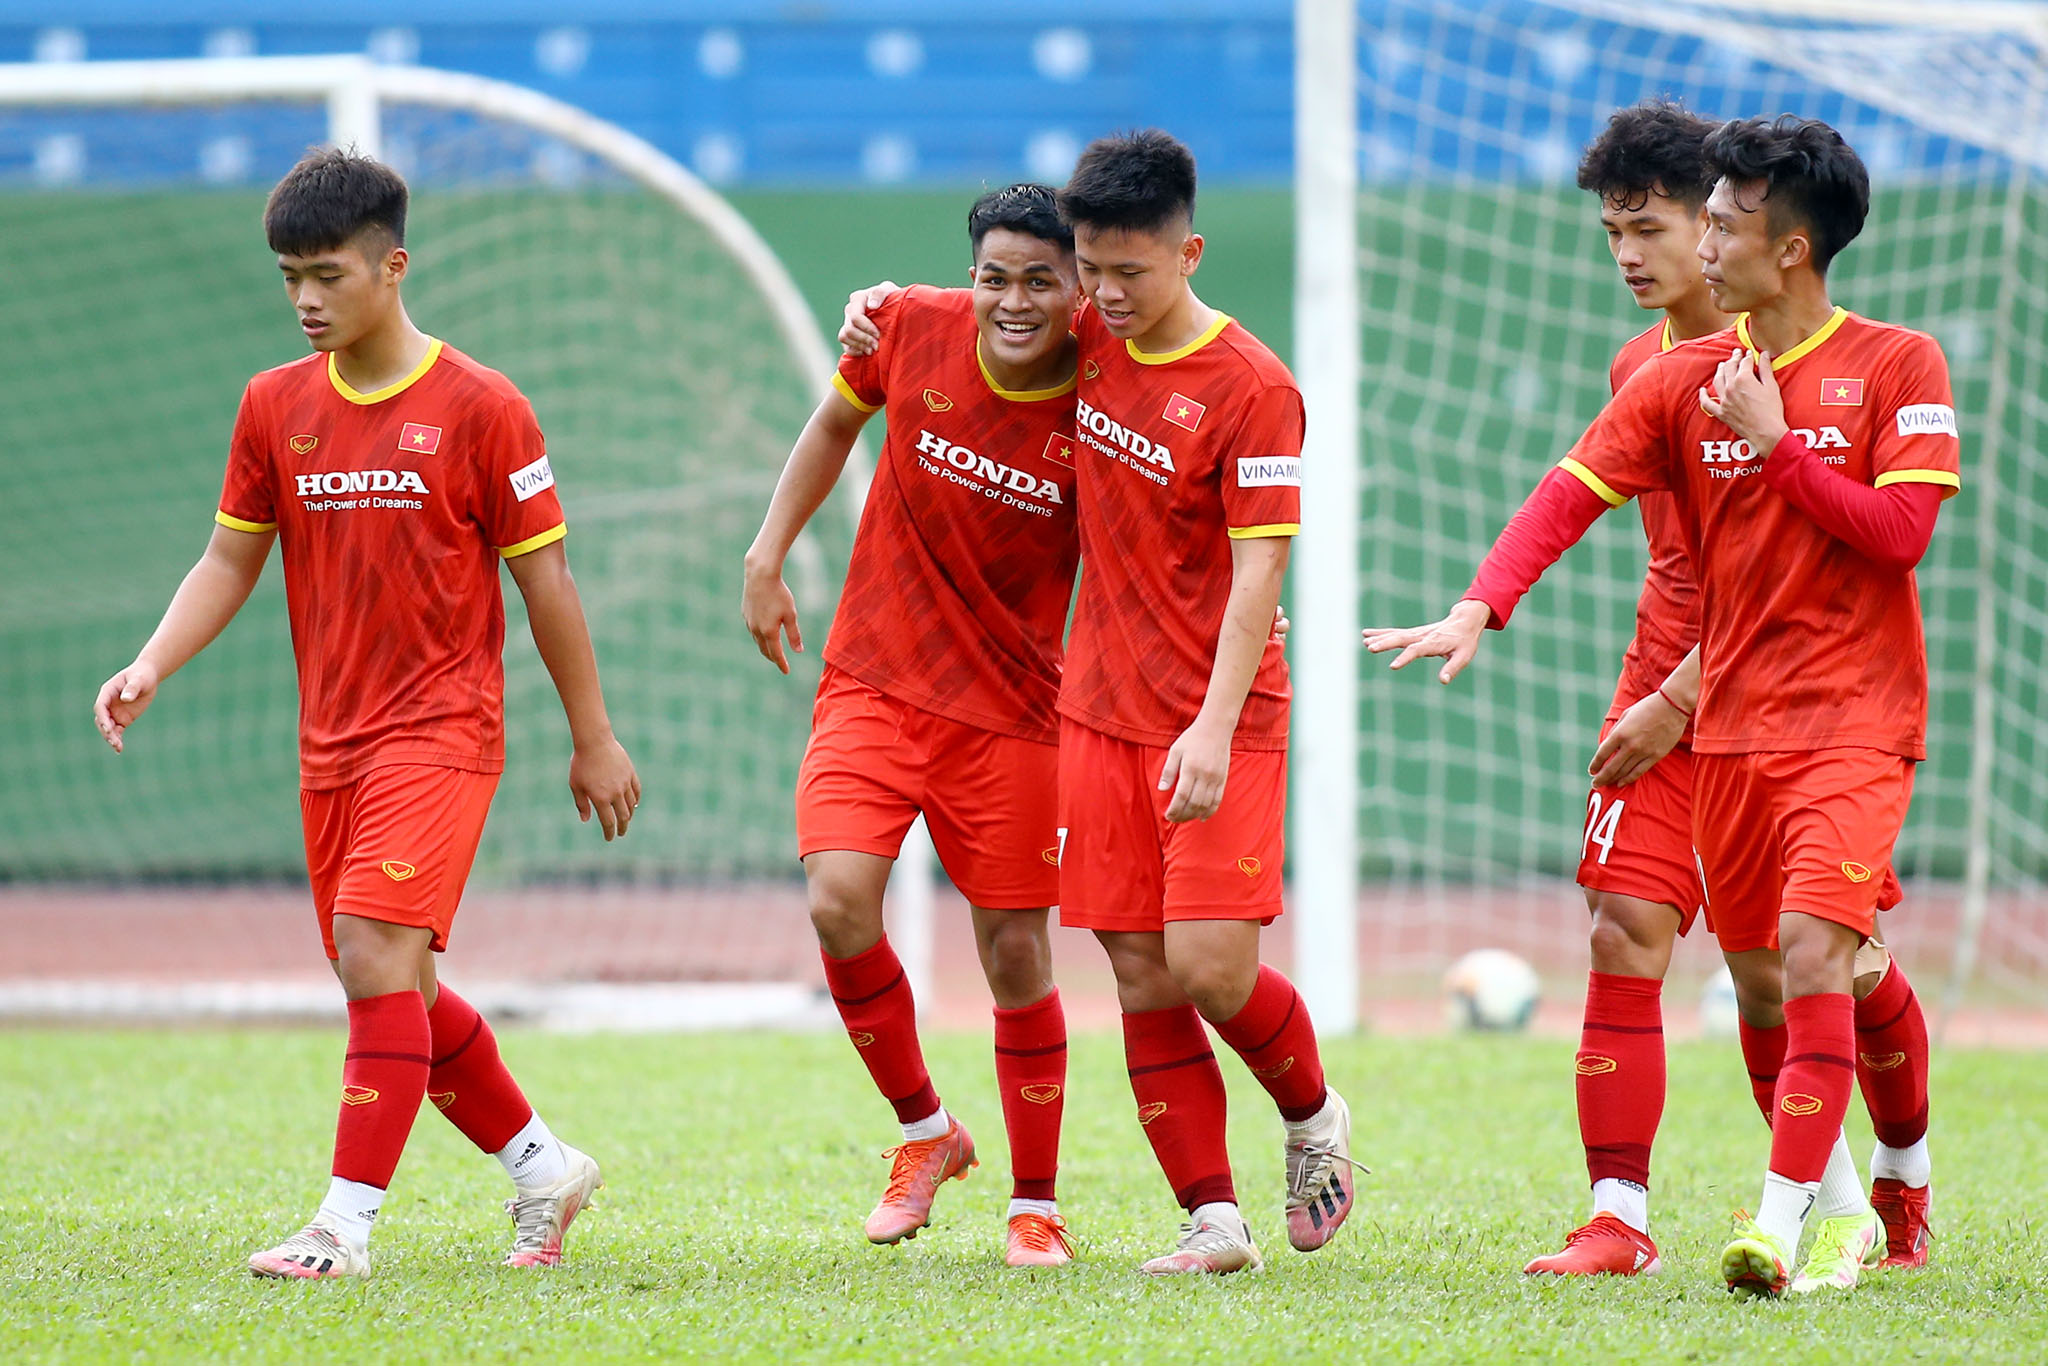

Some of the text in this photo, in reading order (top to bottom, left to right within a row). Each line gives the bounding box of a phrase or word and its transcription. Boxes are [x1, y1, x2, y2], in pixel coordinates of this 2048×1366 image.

[1076, 398, 1176, 473] HONDA
[1700, 426, 1852, 463] HODA
[915, 429, 1064, 505] HONDA
[1086, 434, 1169, 486] Power of Dreams
[1707, 465, 1763, 479] The Pow
[295, 470, 430, 496] HONDA
[918, 455, 1054, 518] The Power of Dreams
[303, 497, 423, 511] The Power of Dreams
[515, 1144, 544, 1168] adidas
